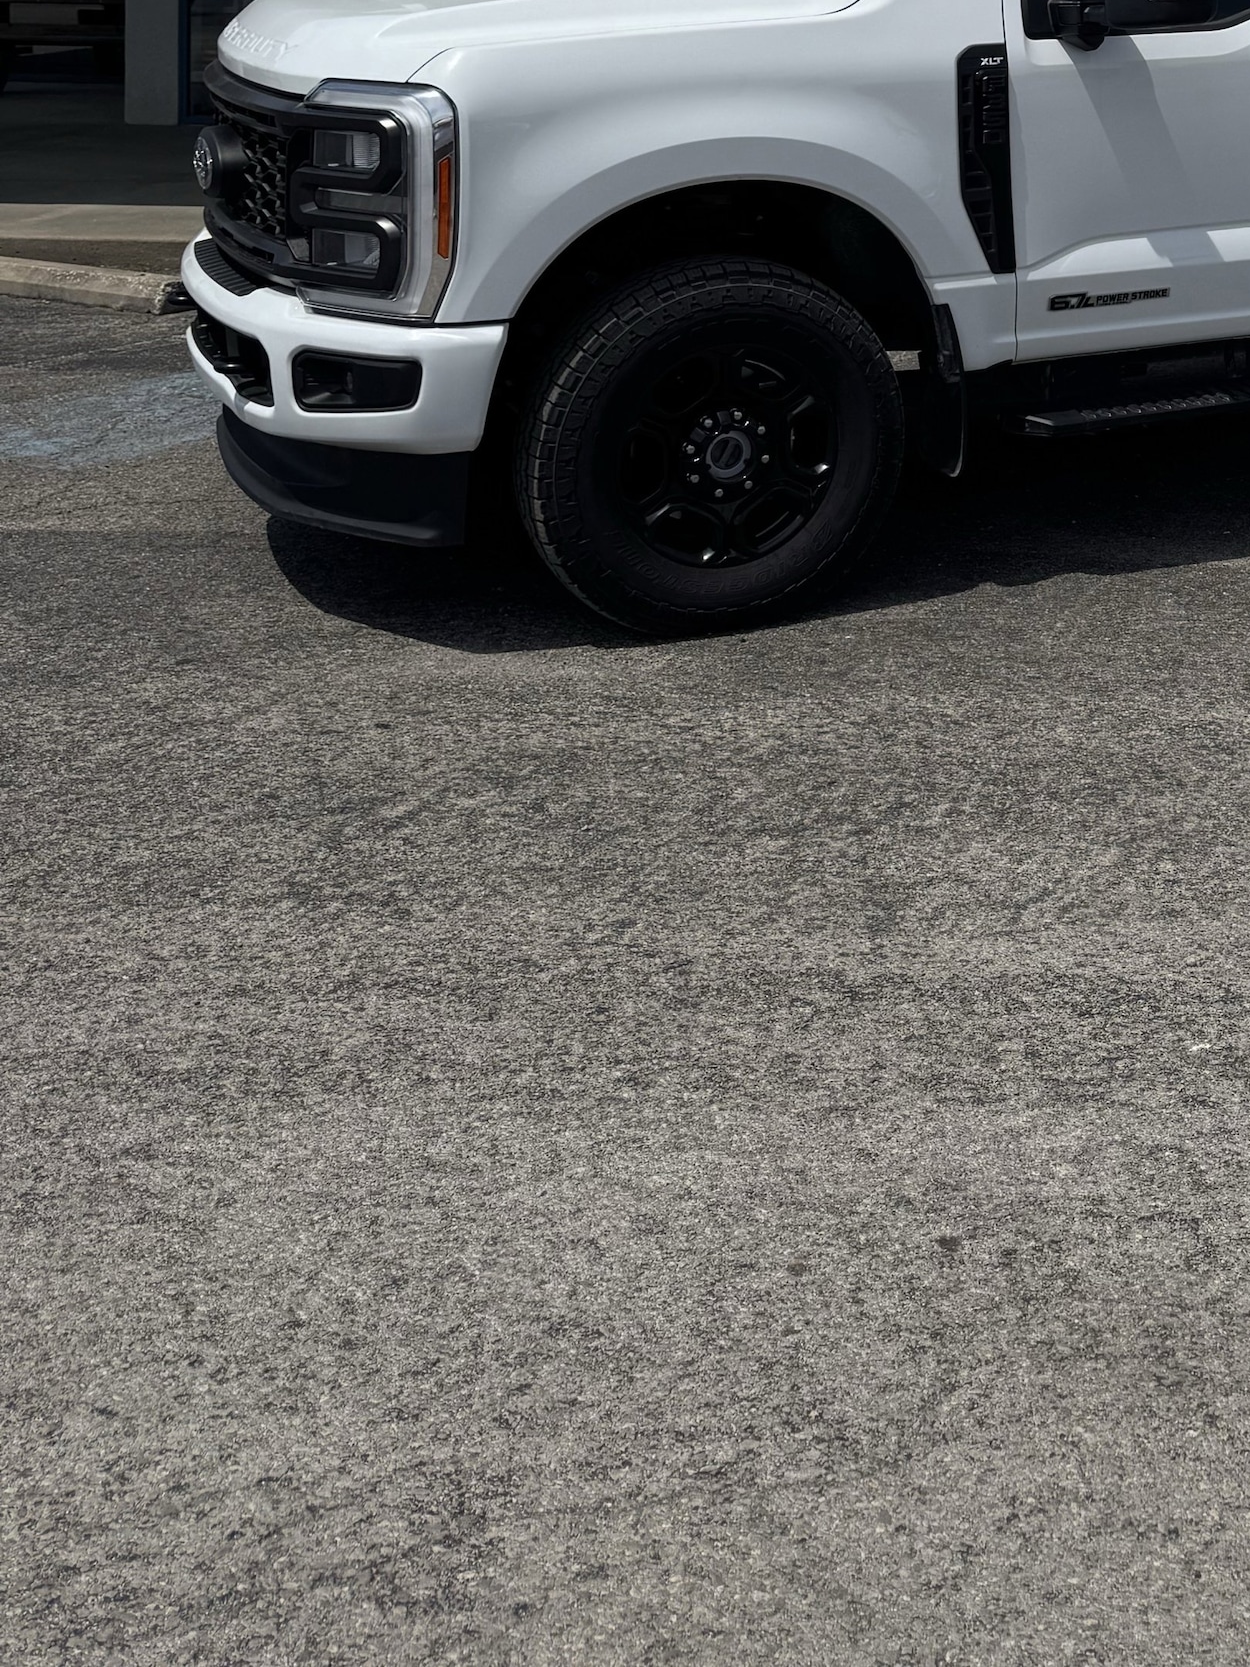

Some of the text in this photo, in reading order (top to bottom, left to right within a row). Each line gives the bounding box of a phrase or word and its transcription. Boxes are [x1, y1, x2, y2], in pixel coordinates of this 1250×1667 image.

[981, 56, 1004, 66] XLT
[1096, 293, 1129, 304] POWER
[1131, 287, 1169, 301] STROKE
